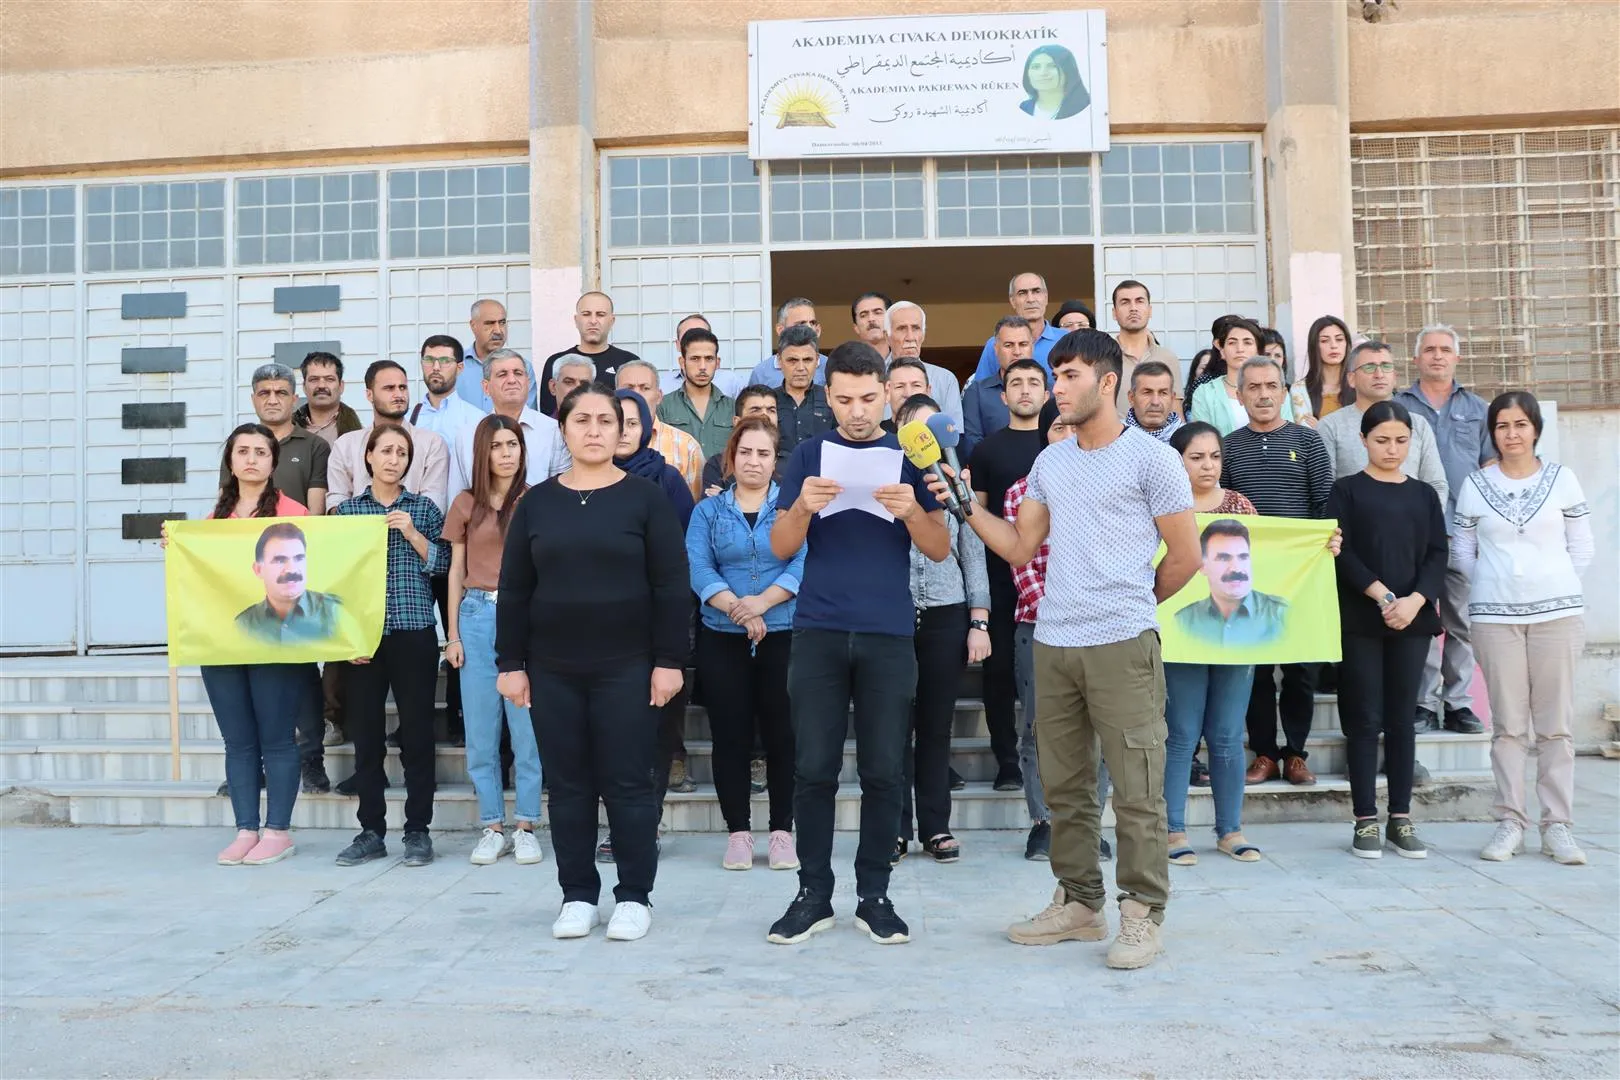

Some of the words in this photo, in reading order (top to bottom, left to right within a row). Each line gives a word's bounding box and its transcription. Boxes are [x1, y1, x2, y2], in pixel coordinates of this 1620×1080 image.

[792, 33, 886, 48] AKADEMIYA
[889, 30, 947, 44] CIVAKA
[849, 85, 916, 96] AKADEMIYA
[917, 82, 978, 93] PAKREWAN
